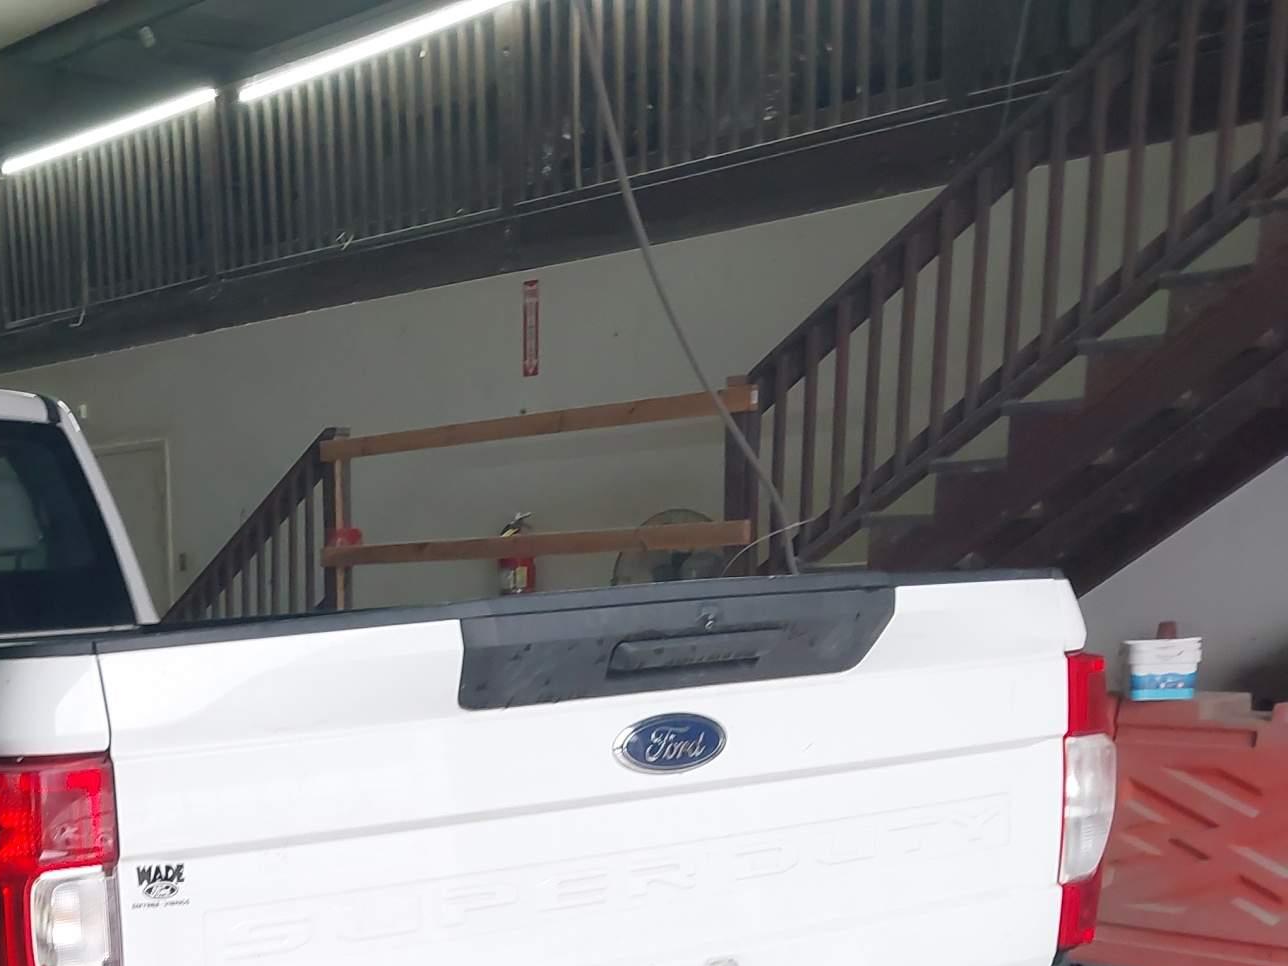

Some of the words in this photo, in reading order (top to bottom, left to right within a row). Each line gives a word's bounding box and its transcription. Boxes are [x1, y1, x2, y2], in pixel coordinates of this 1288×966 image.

[136, 863, 185, 886] WADE
[221, 855, 699, 961] SUPER
[731, 806, 1004, 882] DUTY
